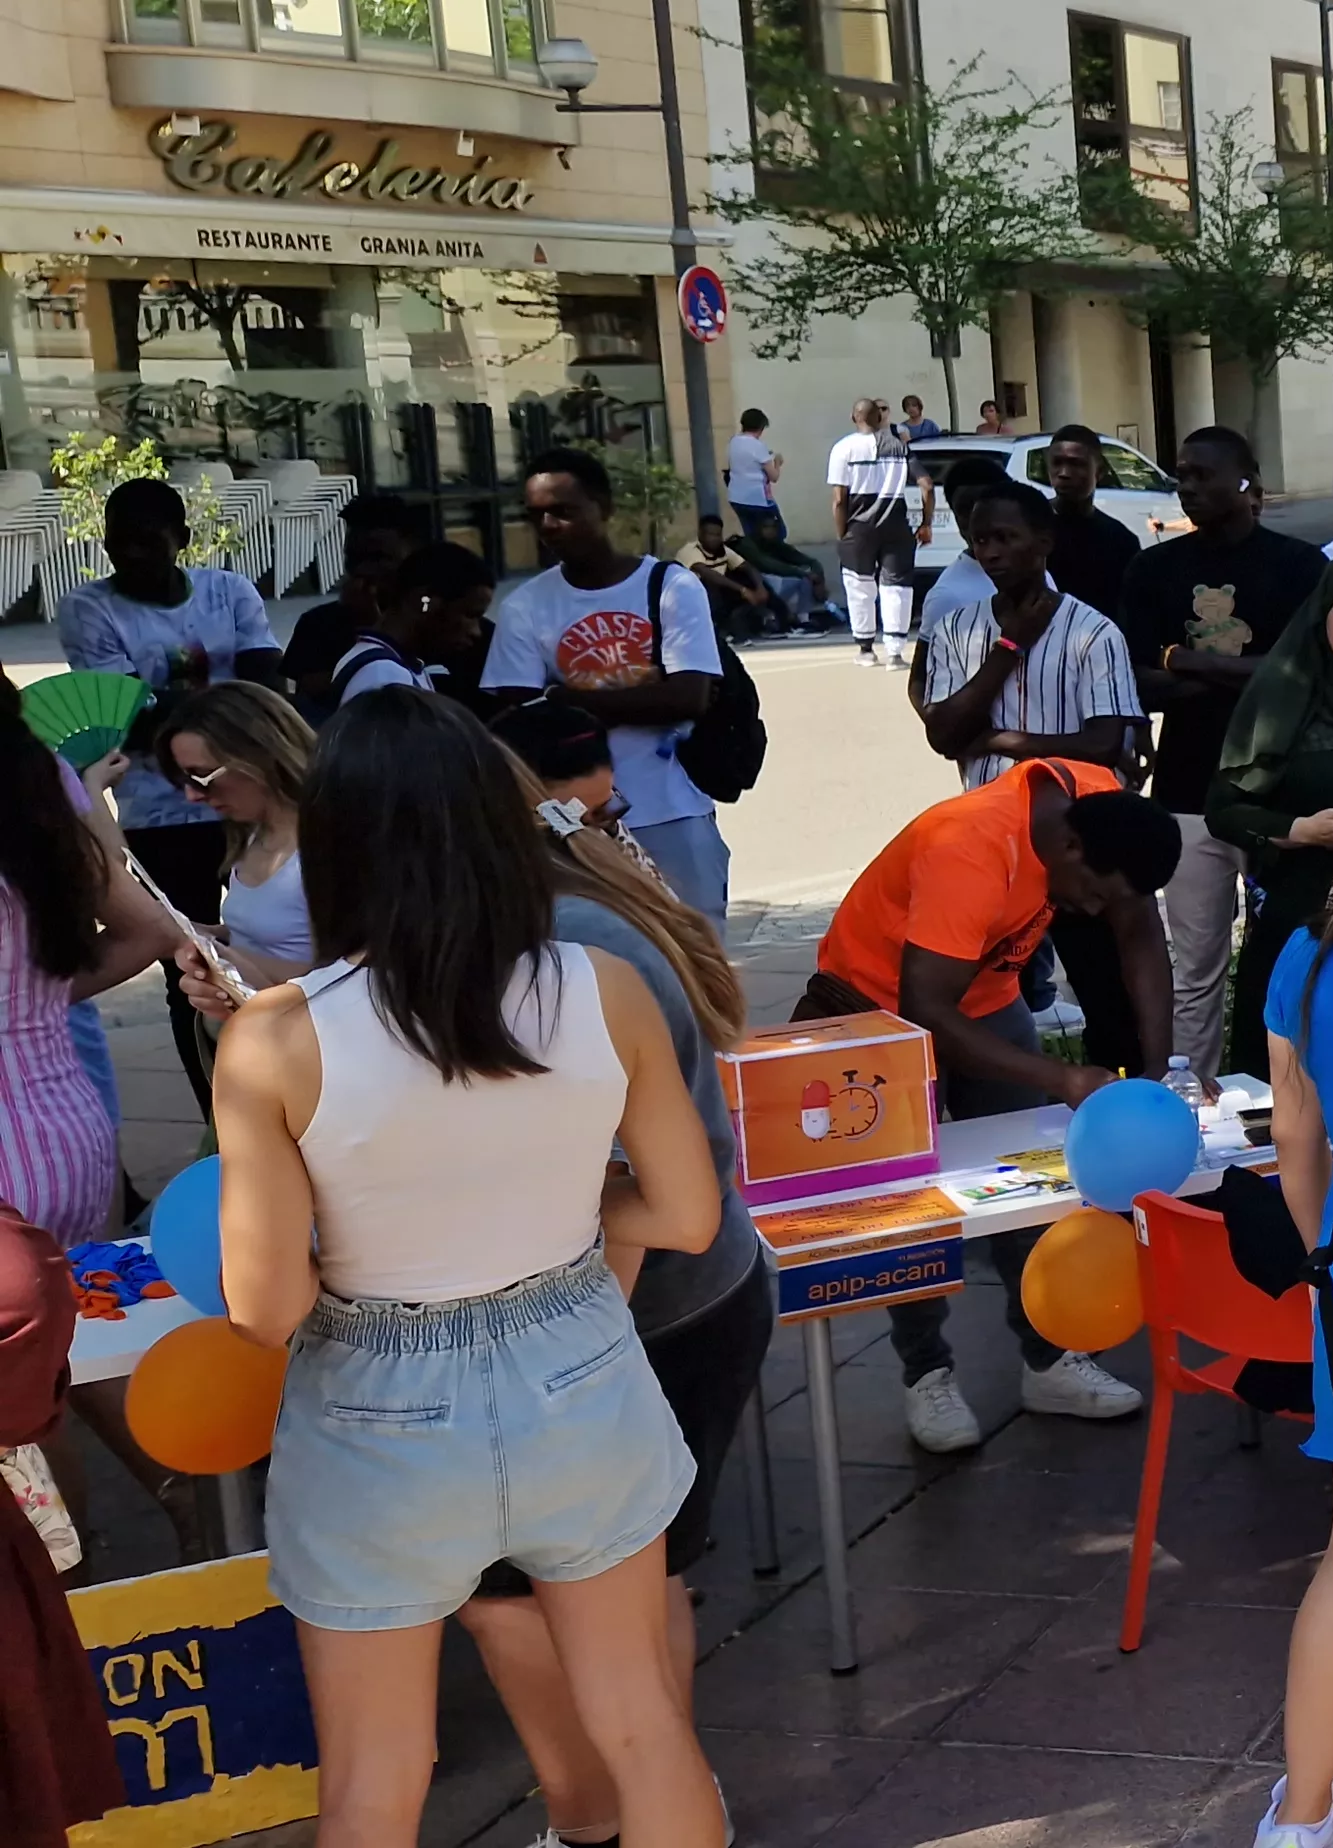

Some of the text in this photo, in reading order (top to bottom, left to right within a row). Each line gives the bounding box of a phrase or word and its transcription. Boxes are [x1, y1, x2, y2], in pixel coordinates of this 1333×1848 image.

[197, 229, 485, 259] RESTAURANTE GRANJA ANITA
[561, 613, 645, 652] CHASE
[569, 641, 630, 667] THE
[808, 1260, 946, 1301] apip-acam
